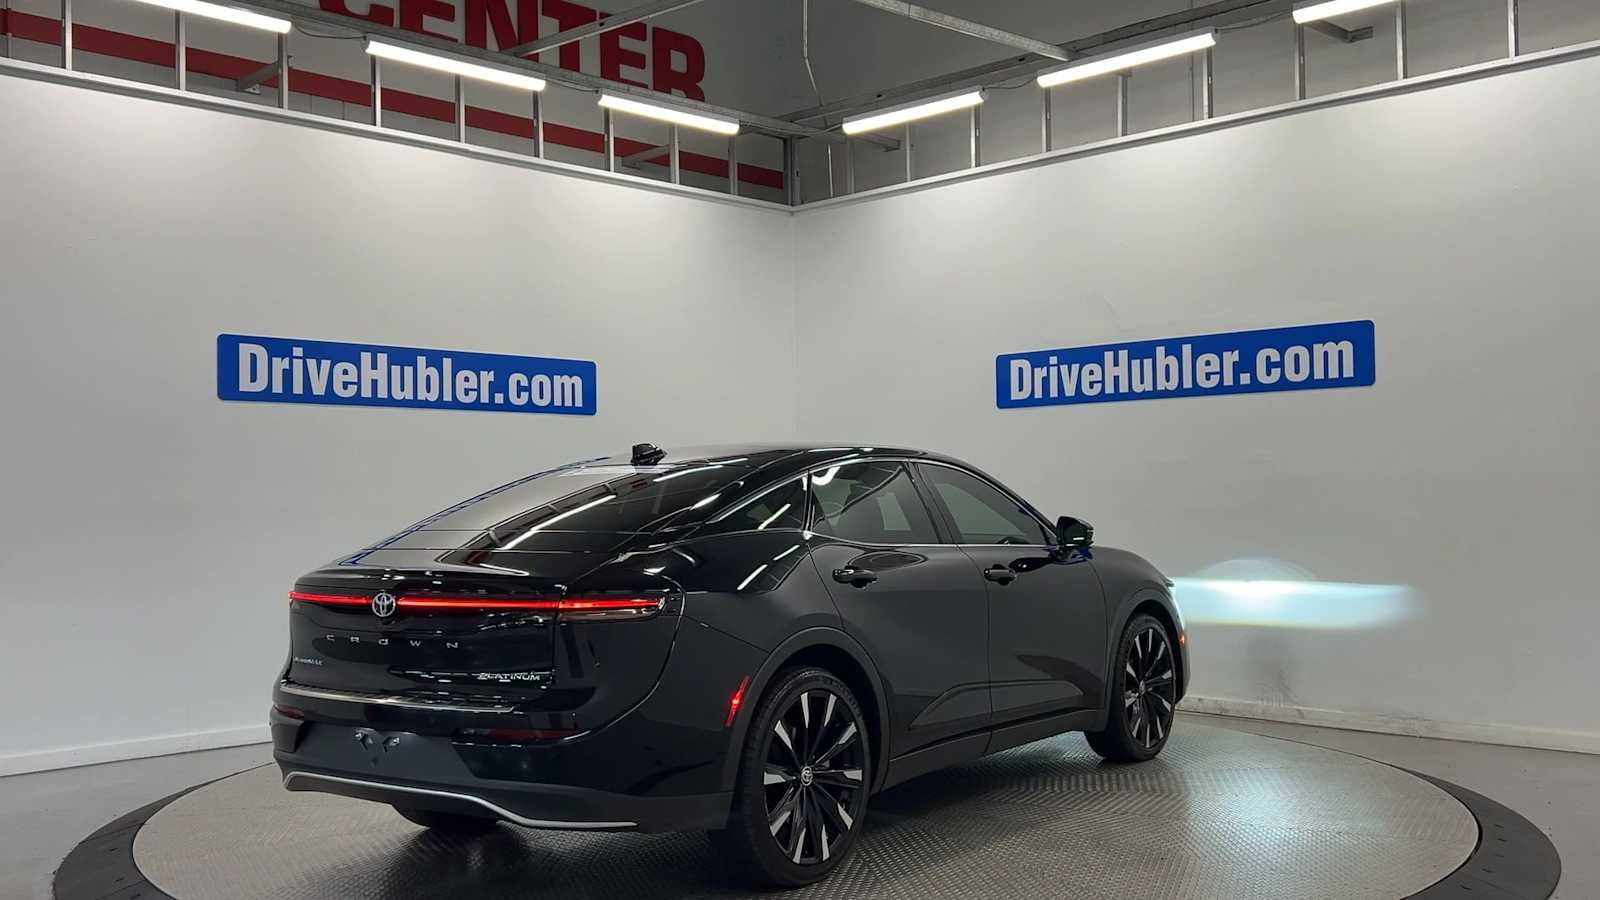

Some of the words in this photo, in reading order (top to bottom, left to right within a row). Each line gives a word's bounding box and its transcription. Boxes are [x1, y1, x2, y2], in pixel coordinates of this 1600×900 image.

[238, 343, 583, 407] DriveHubler.com
[1010, 340, 1354, 400] DriveHubler.com
[326, 634, 458, 649] CROWN
